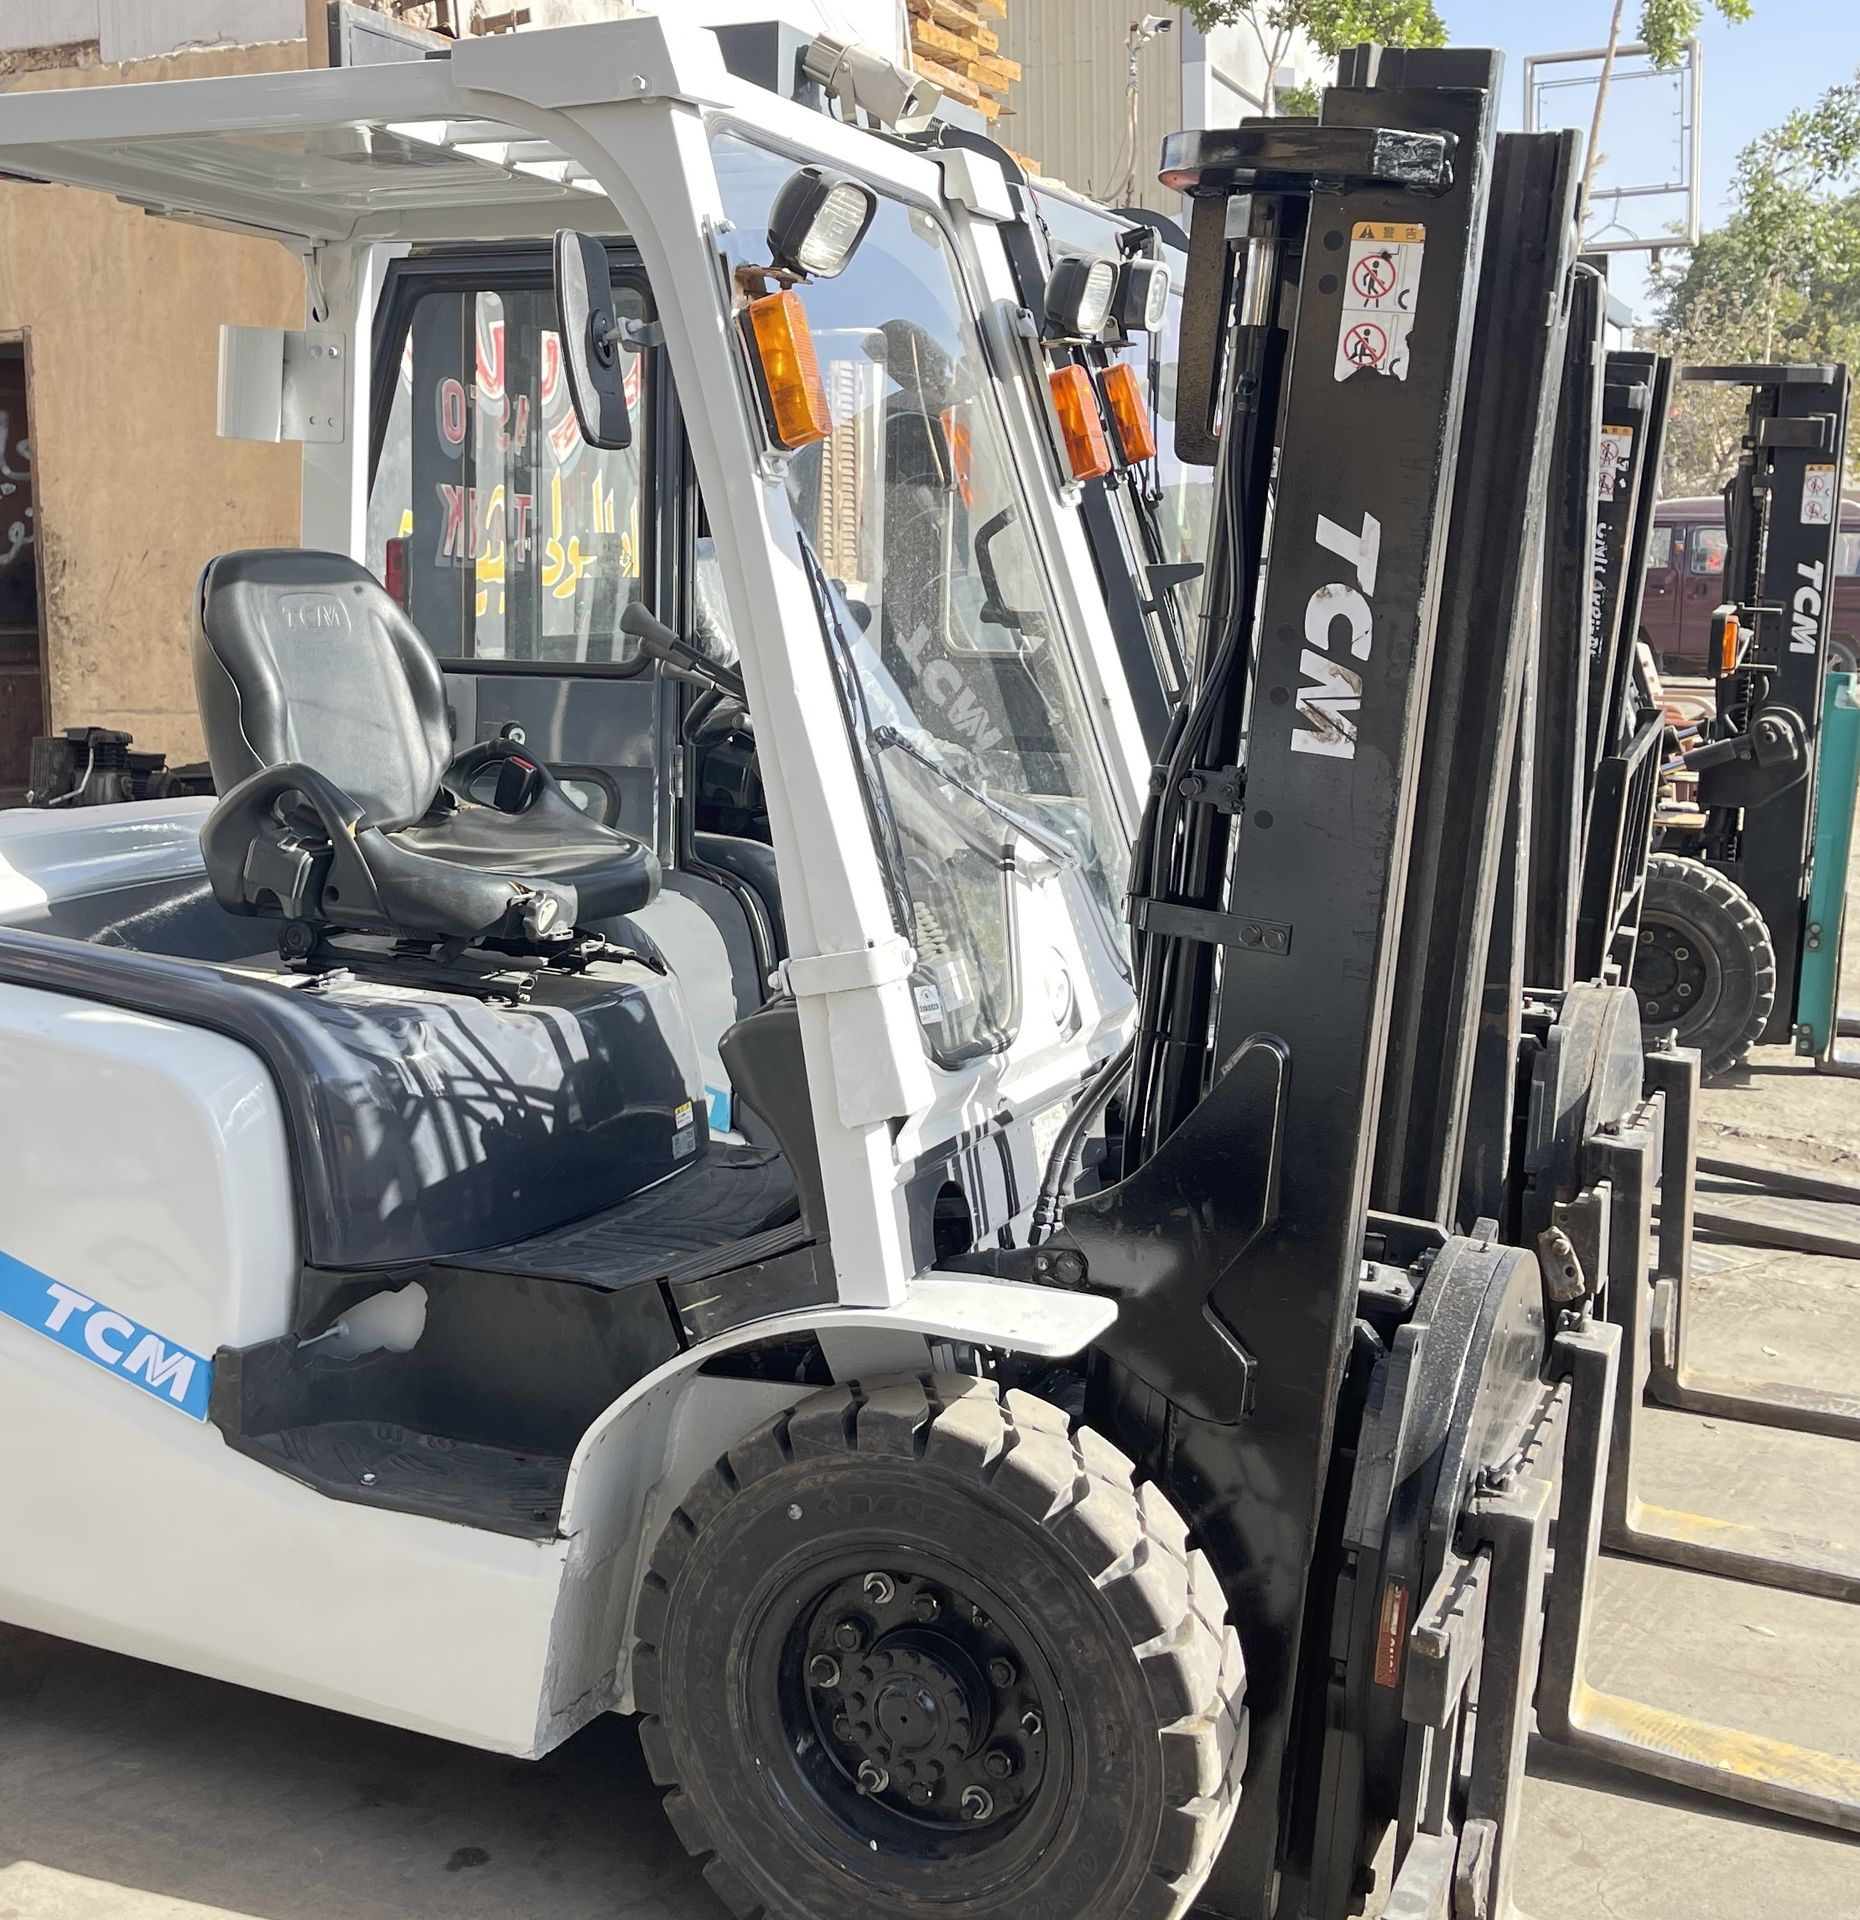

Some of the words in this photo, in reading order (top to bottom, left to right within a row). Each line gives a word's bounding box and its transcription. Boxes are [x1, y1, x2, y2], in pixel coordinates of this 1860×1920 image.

[1290, 511, 1381, 759] TCM
[1789, 560, 1824, 655] TCM
[44, 1282, 196, 1403] TCM
